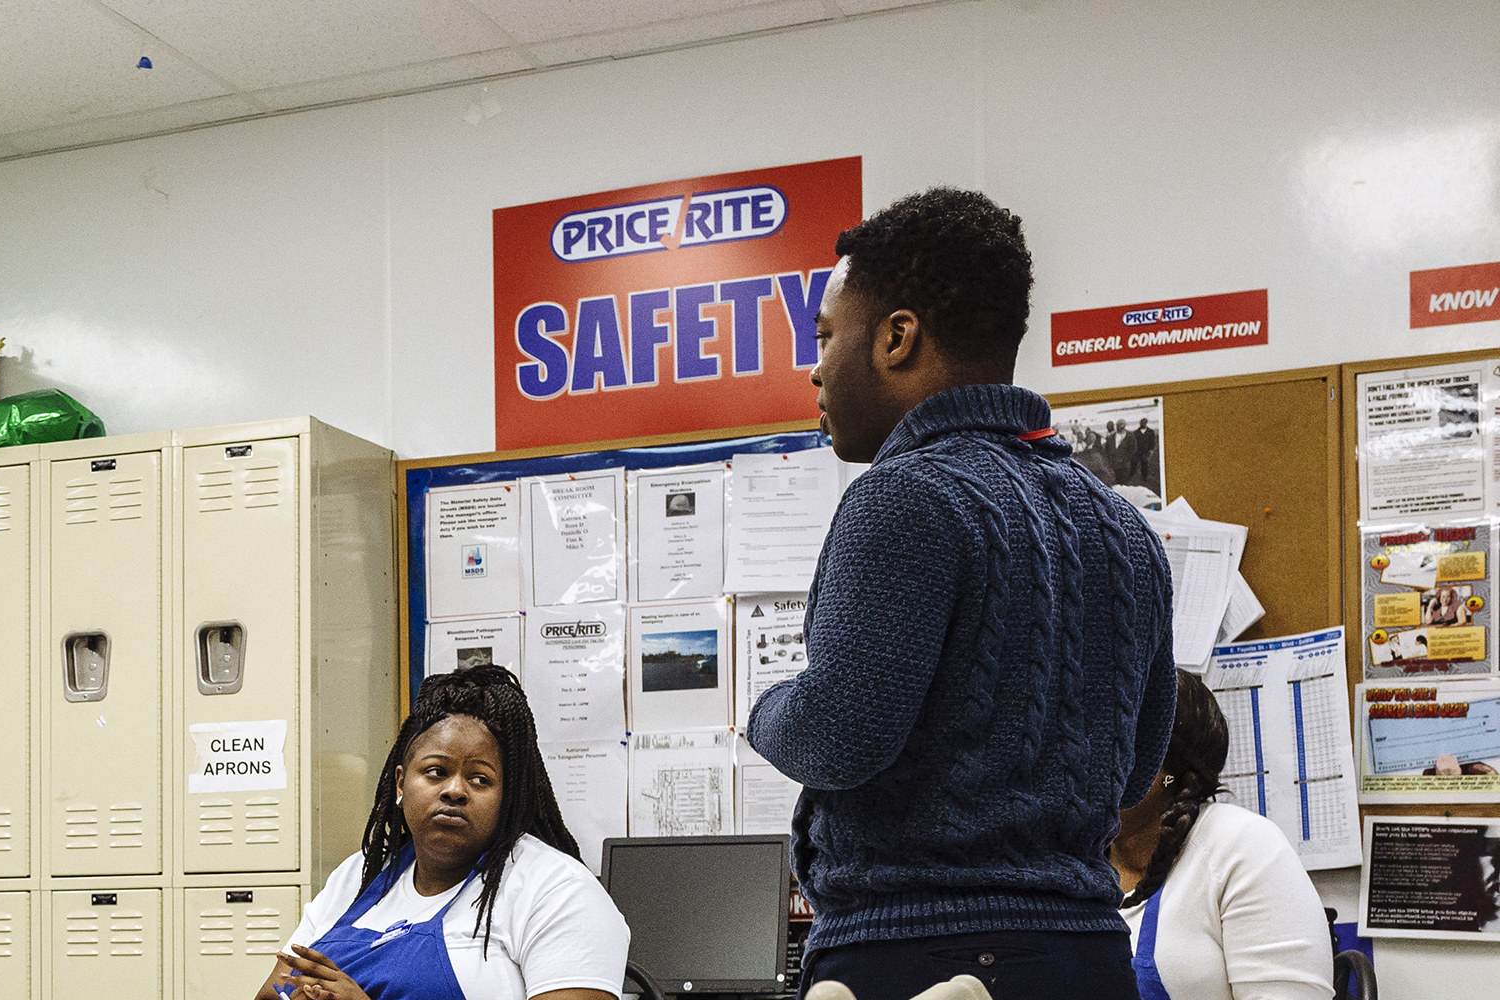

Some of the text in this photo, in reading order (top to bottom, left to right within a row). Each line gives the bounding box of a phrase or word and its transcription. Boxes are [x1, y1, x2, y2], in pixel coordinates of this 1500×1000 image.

[562, 194, 774, 254] PRICE RITE
[1429, 287, 1499, 313] KNOW
[1126, 308, 1189, 323] PRICE RITE
[516, 269, 835, 400] SAFETY
[1056, 321, 1261, 357] GENERAL COMMUNICATION
[554, 493, 592, 501] COMMITTEE
[774, 600, 807, 612] Safety
[546, 624, 600, 636] PRICE RITE
[210, 737, 264, 752] CLEAN
[203, 760, 271, 776] APRONS
